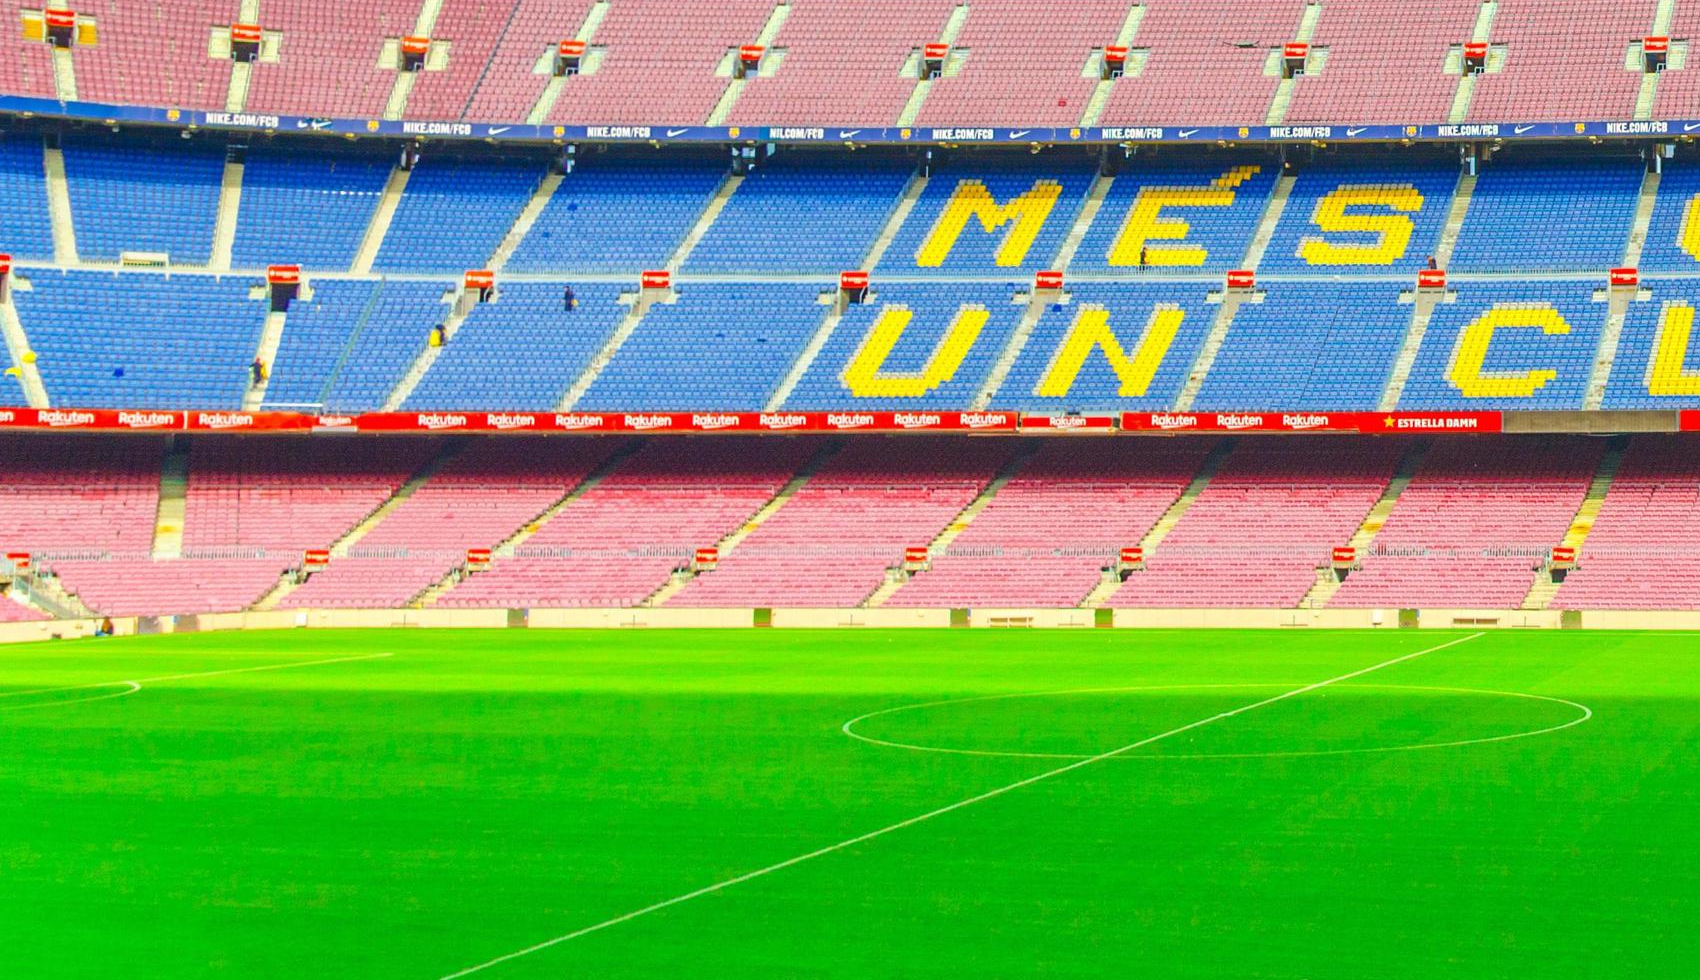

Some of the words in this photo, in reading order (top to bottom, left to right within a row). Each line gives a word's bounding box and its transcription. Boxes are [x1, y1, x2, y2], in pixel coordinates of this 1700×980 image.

[908, 165, 1424, 268] MÉS
[838, 303, 1185, 398] UN
[38, 411, 94, 426] Rakuten
[119, 412, 173, 427] Rakuten
[199, 413, 252, 428] Rakuten
[418, 414, 466, 429] Rakuten
[488, 414, 534, 428] Rakuten
[556, 415, 602, 429] Rakuten
[625, 415, 671, 429] Rakuten
[693, 414, 739, 428] Rakuten
[760, 414, 806, 428] Rakuten
[828, 414, 873, 428] Rakuten
[895, 414, 940, 428] Rakuten
[961, 413, 1006, 428] Rakuten
[1049, 416, 1087, 428] Rakuten
[1152, 414, 1196, 429] Rakuten
[1218, 415, 1262, 429] Rakuten
[1283, 415, 1328, 429] Rakuten
[1397, 418, 1444, 428] ESTRELLA
[1446, 418, 1477, 428] DAMM
